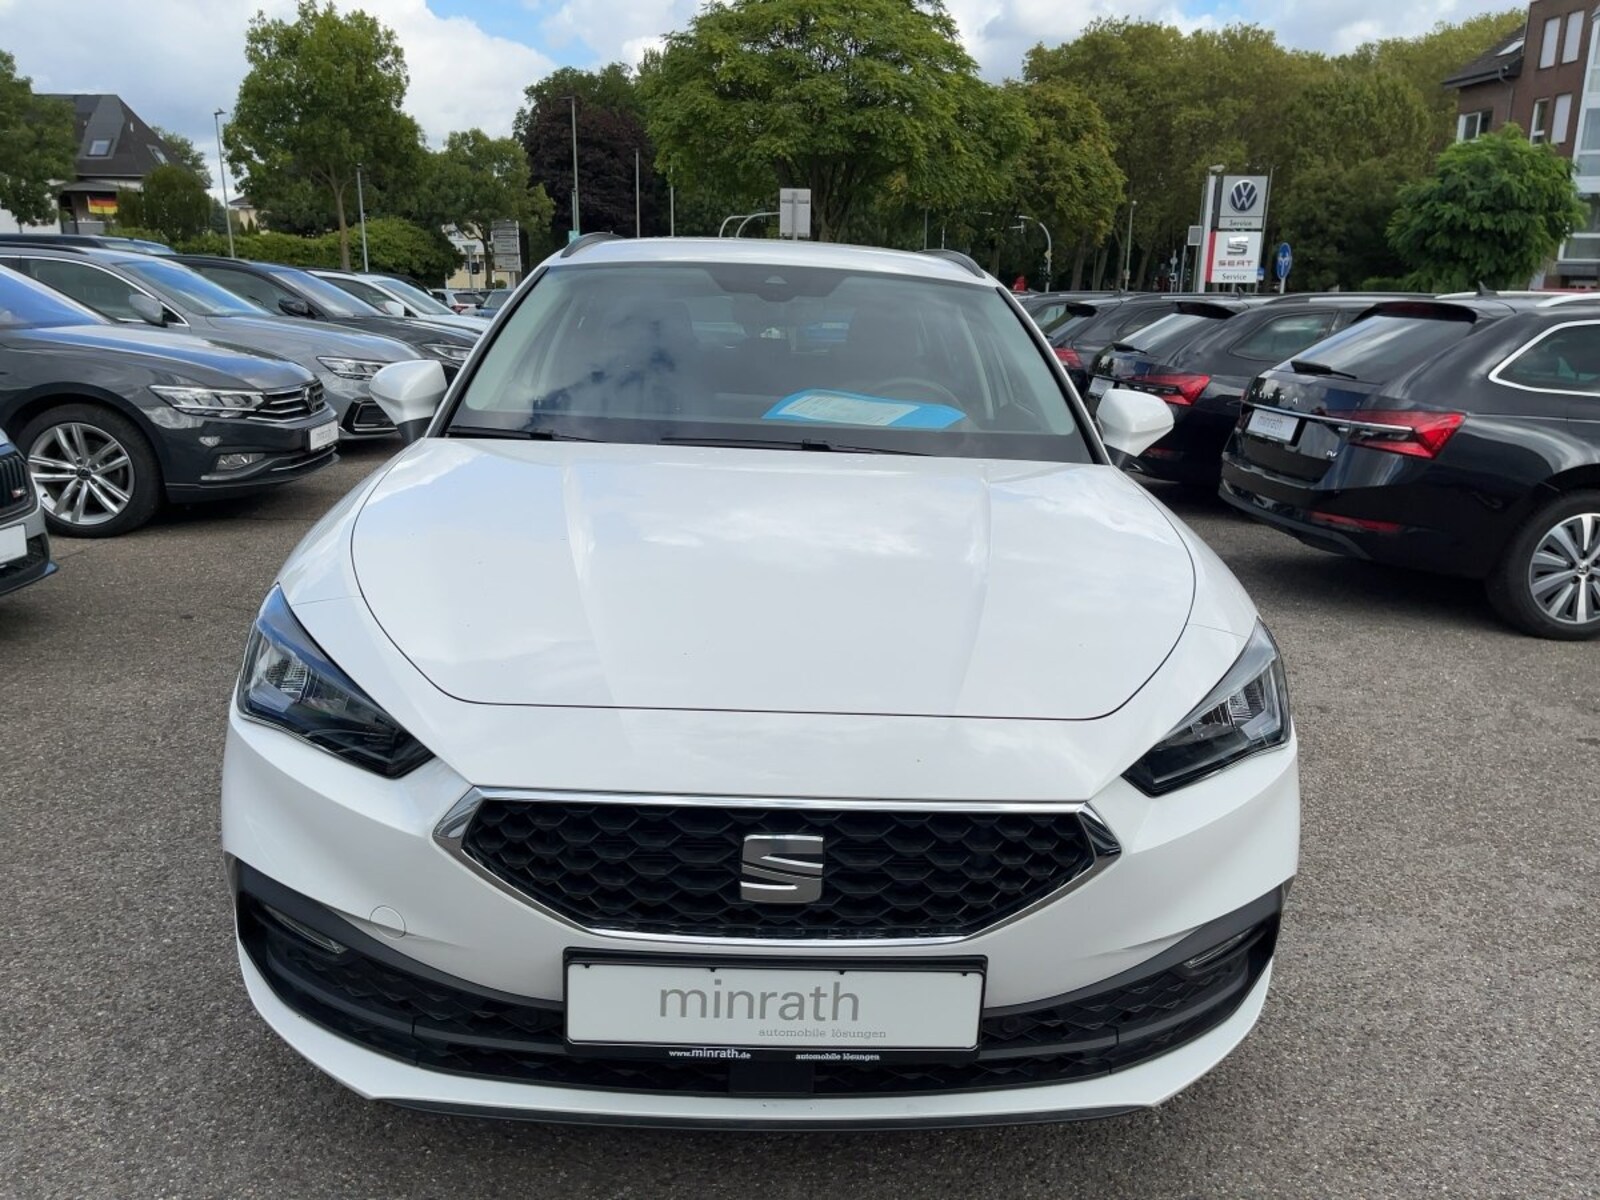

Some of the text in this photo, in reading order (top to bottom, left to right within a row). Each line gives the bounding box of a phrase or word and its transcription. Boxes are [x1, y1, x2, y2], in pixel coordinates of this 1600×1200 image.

[1222, 272, 1247, 280] Service
[660, 978, 860, 1022] minrath
[759, 1028, 886, 1039] automobile lösungen
[669, 1047, 752, 1059] www.minrath.de
[843, 1053, 880, 1061] lösungen
